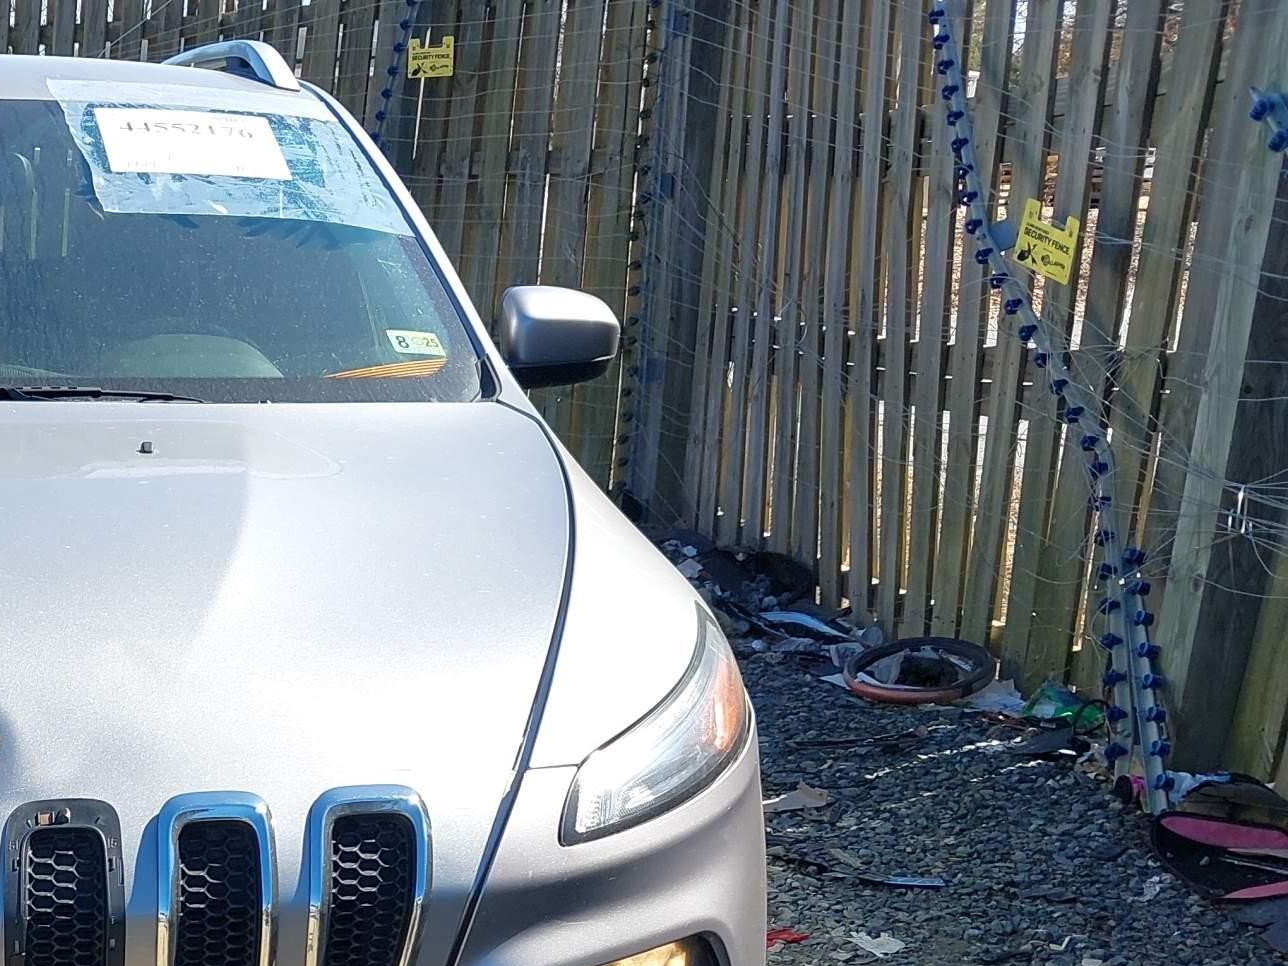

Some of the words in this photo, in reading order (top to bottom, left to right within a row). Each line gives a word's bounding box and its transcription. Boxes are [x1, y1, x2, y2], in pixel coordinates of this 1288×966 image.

[1024, 226, 1053, 246] SECURITY
[1052, 239, 1070, 256] FENCE
[395, 335, 410, 349] 8
